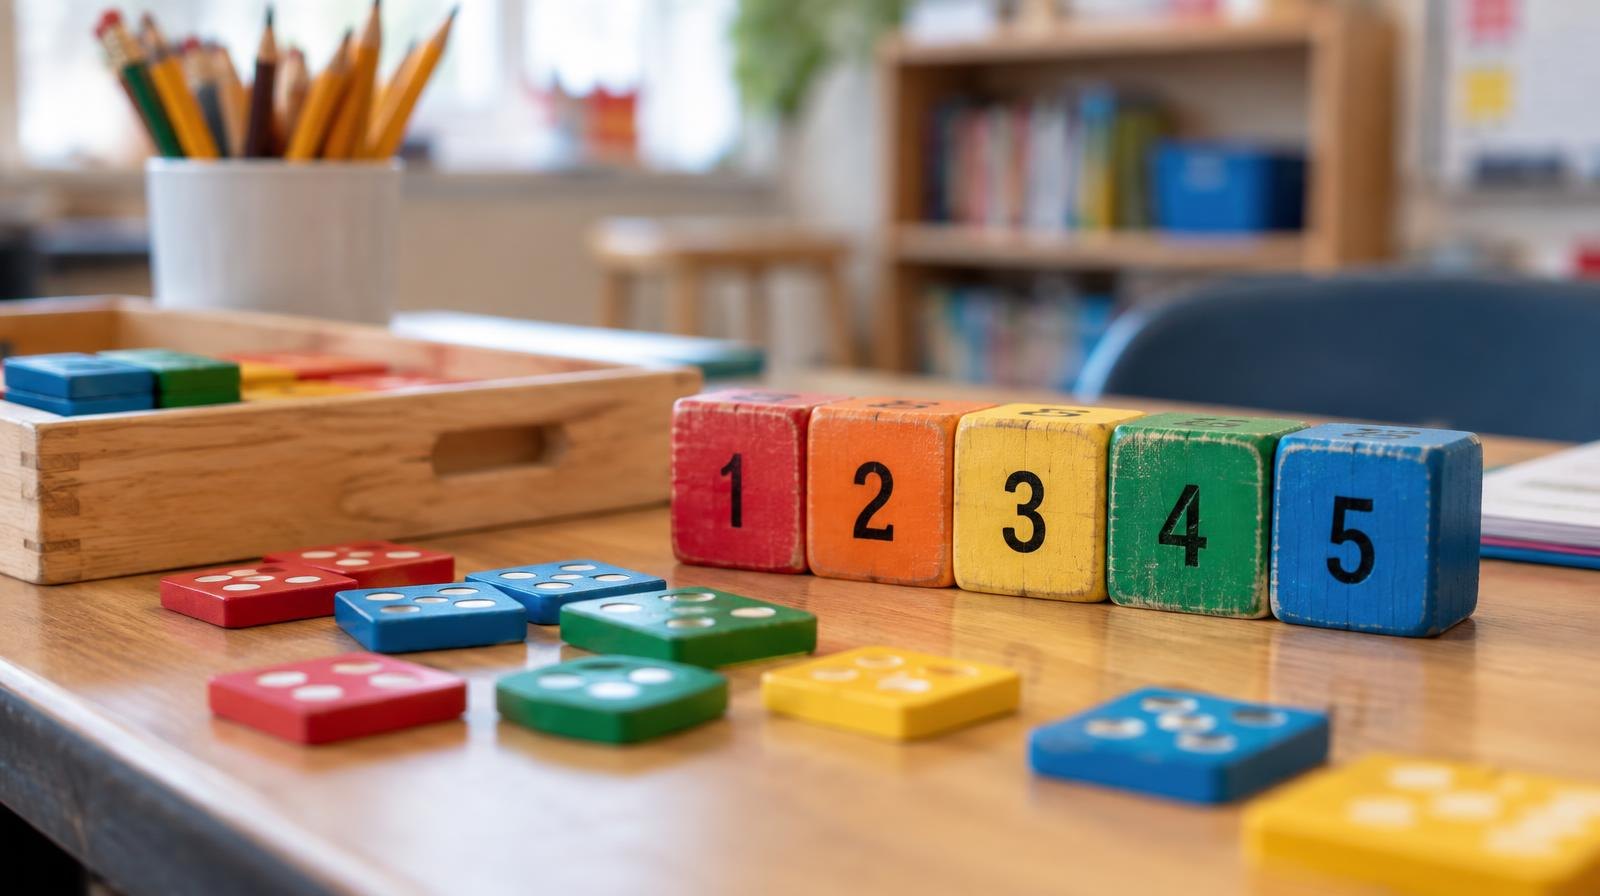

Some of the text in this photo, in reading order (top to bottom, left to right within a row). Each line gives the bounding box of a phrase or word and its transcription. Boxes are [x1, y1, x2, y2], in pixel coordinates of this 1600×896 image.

[720, 454, 741, 528] 1
[854, 462, 894, 541] 2
[1003, 471, 1046, 554] 3
[1158, 484, 1208, 568] 4
[1327, 496, 1375, 585] 5
